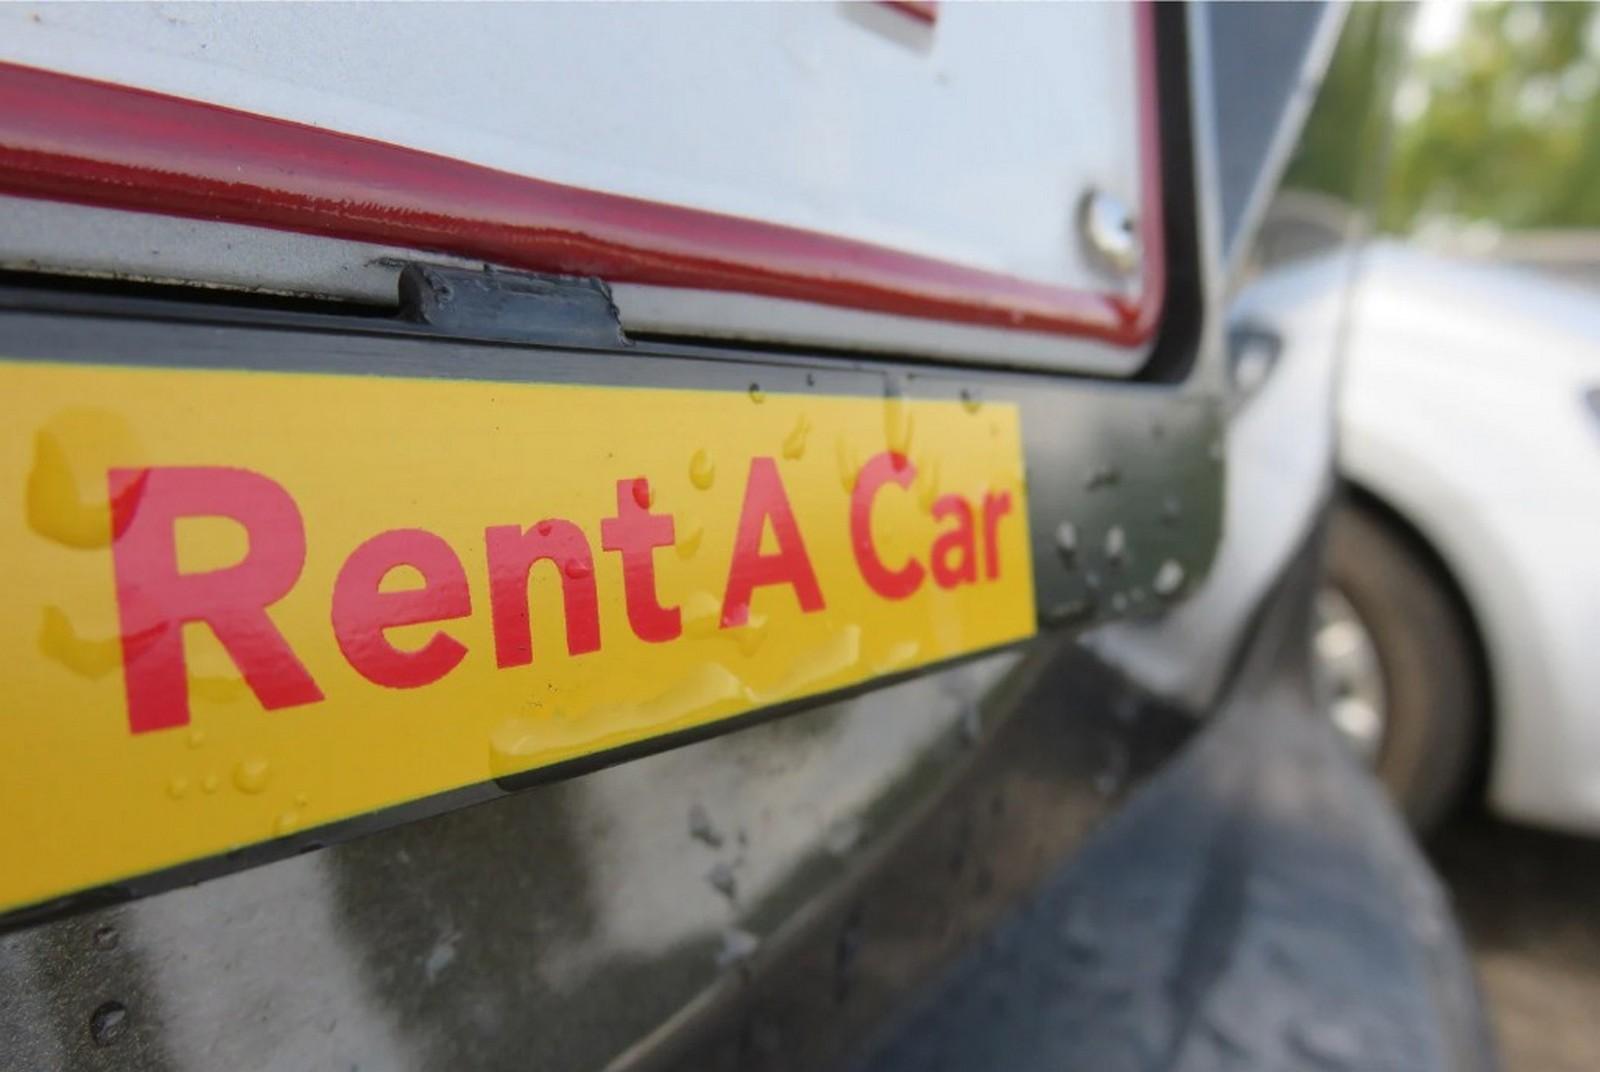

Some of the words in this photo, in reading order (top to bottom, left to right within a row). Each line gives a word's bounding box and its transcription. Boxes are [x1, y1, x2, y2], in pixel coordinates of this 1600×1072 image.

[107, 465, 683, 735] Rent
[719, 456, 826, 629] A
[849, 451, 1012, 601] Car
